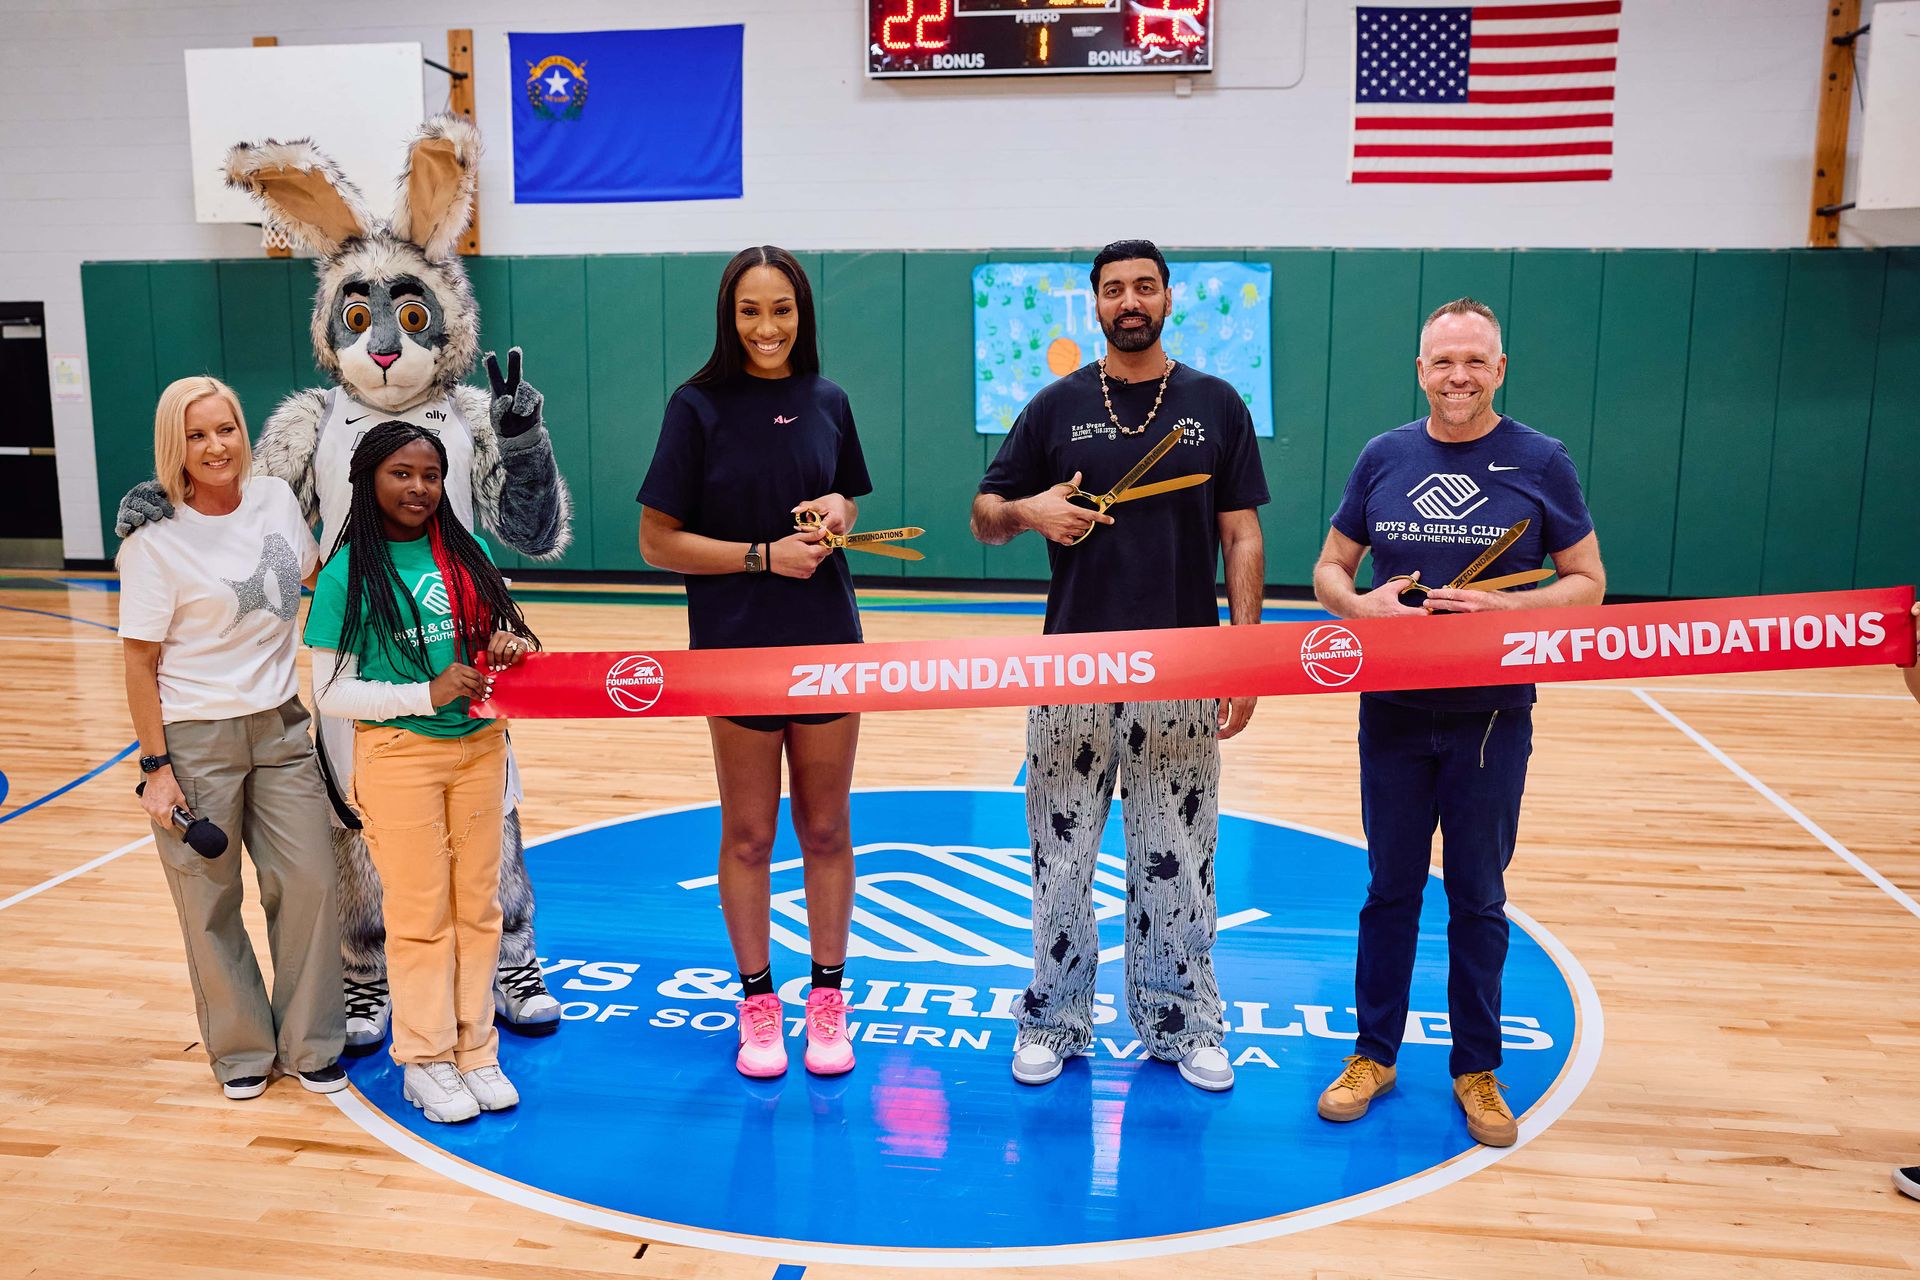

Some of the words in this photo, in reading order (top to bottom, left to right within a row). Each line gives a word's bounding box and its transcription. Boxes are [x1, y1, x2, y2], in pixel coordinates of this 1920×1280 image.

[1015, 12, 1060, 24] PERIOD
[1039, 27, 1048, 61] 1
[932, 53, 985, 69] BONUS
[1088, 50, 1142, 66] BONUS
[425, 410, 447, 422] ally
[1375, 520, 1406, 532] BOYS
[1408, 521, 1421, 533] &
[1423, 523, 1468, 535] GIRLS
[1387, 532, 1400, 540] OF
[1401, 533, 1456, 544] SOUTHERN
[427, 623, 440, 634] &
[1328, 637, 1353, 650] 2K
[1300, 649, 1363, 661] FOUNDATIONS
[633, 665, 658, 677] 2K
[605, 676, 664, 686] FOUNDATIONS
[656, 968, 748, 1001] &
[559, 1001, 640, 1023] OF
